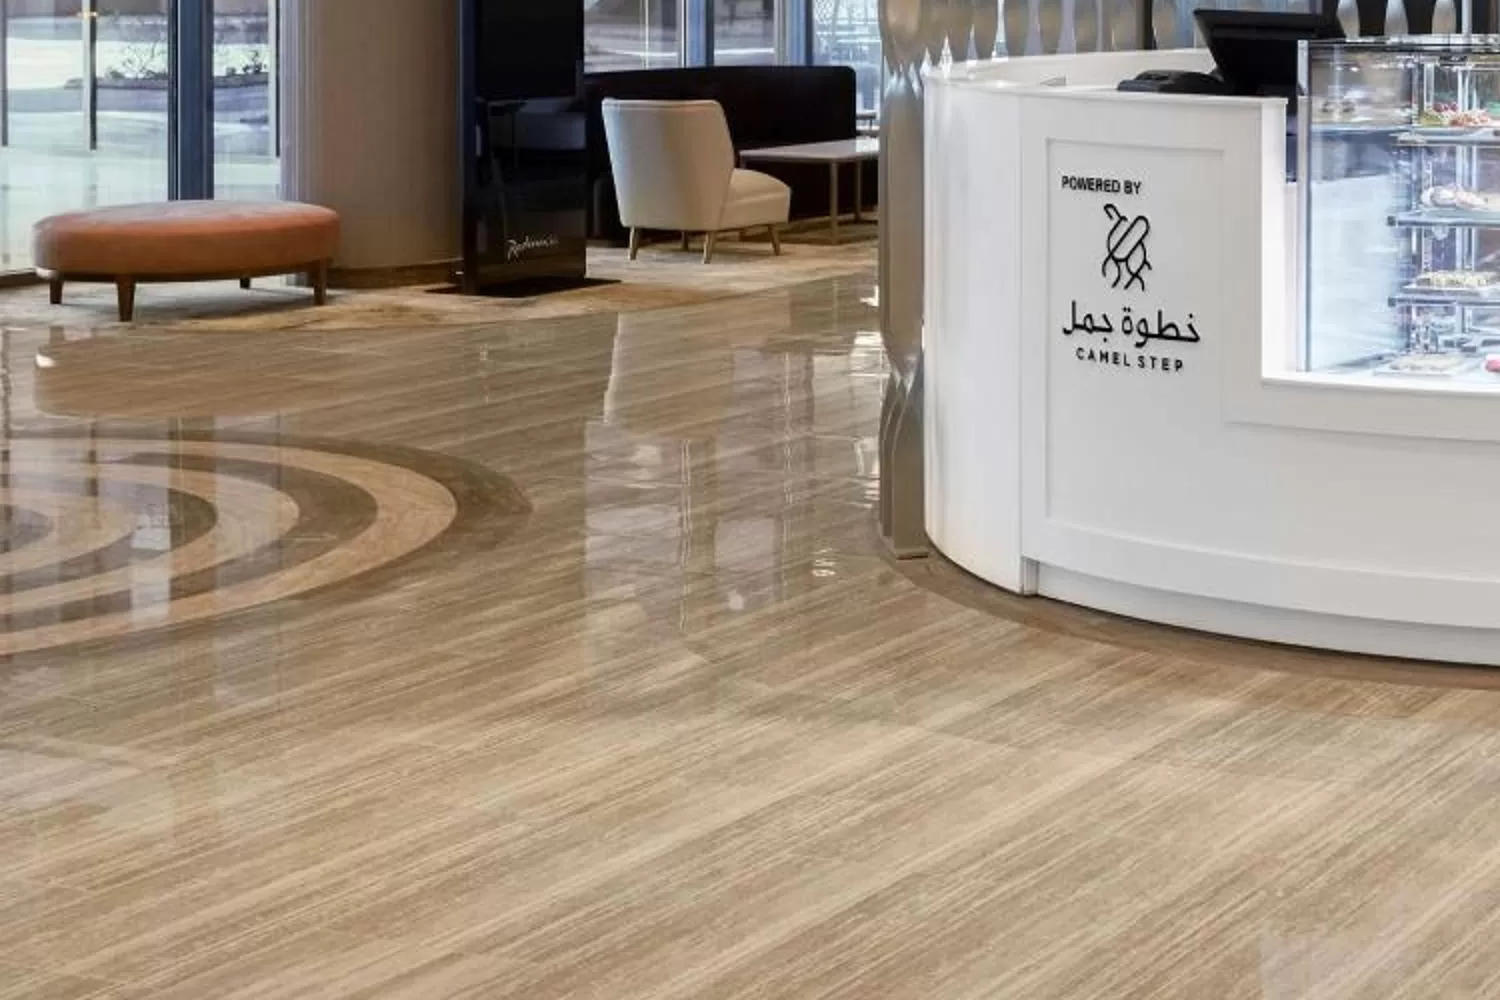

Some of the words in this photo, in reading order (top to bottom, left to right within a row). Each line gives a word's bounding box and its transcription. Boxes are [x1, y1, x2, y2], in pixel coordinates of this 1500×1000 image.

[1061, 175, 1121, 194] POWERED
[1123, 179, 1143, 195] BY
[1062, 299, 1114, 344] جمل
[1121, 306, 1201, 349] خطوة
[1075, 346, 1131, 368] CAMEL
[1137, 355, 1184, 373] STEP
